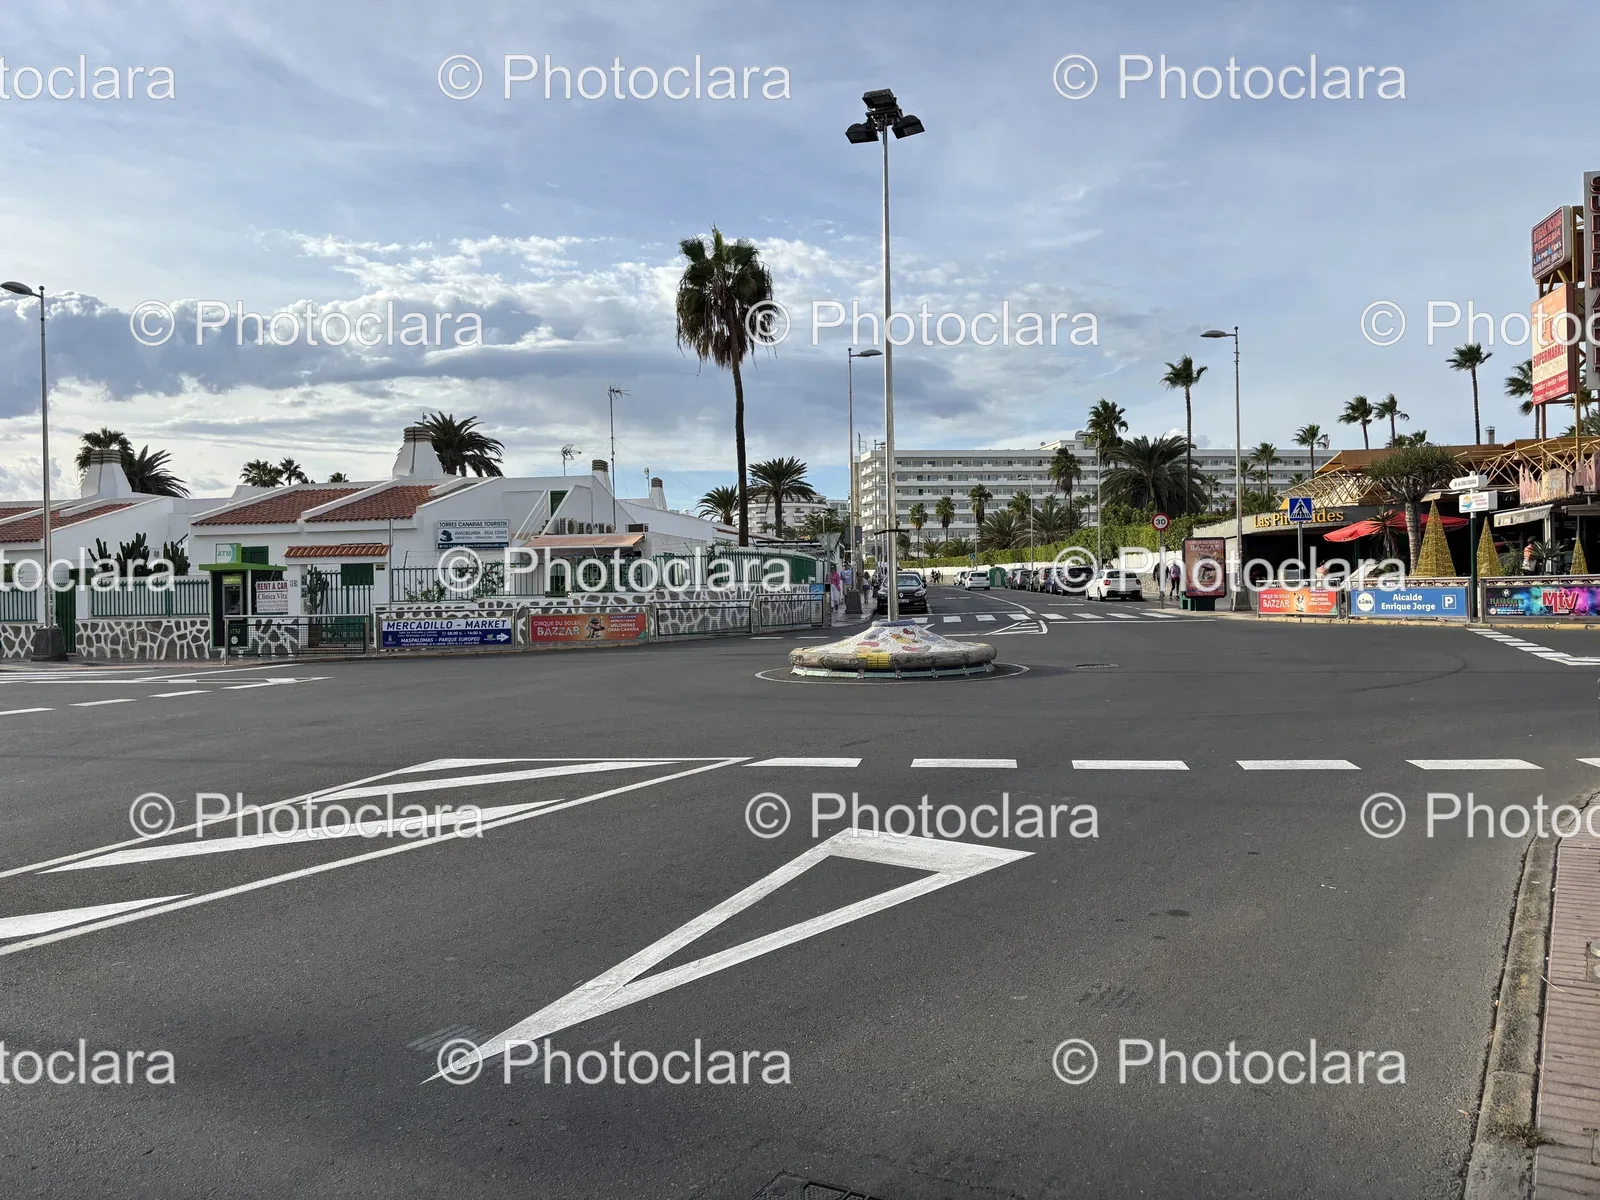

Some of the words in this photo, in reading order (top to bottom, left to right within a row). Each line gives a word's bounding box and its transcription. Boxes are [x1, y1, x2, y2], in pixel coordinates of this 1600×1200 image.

[1534, 228, 1561, 252] PIZZERIA
[1533, 344, 1566, 368] SUPERMARKET
[1254, 515, 1271, 528] Las
[1273, 508, 1344, 526] Pirides
[1381, 603, 1412, 611] Enrique
[1413, 603, 1436, 611] Jorge
[1445, 597, 1453, 608] P
[386, 621, 453, 630] MERCADILLO
[465, 620, 506, 629] MARKET
[537, 627, 580, 636] BAZZAR
